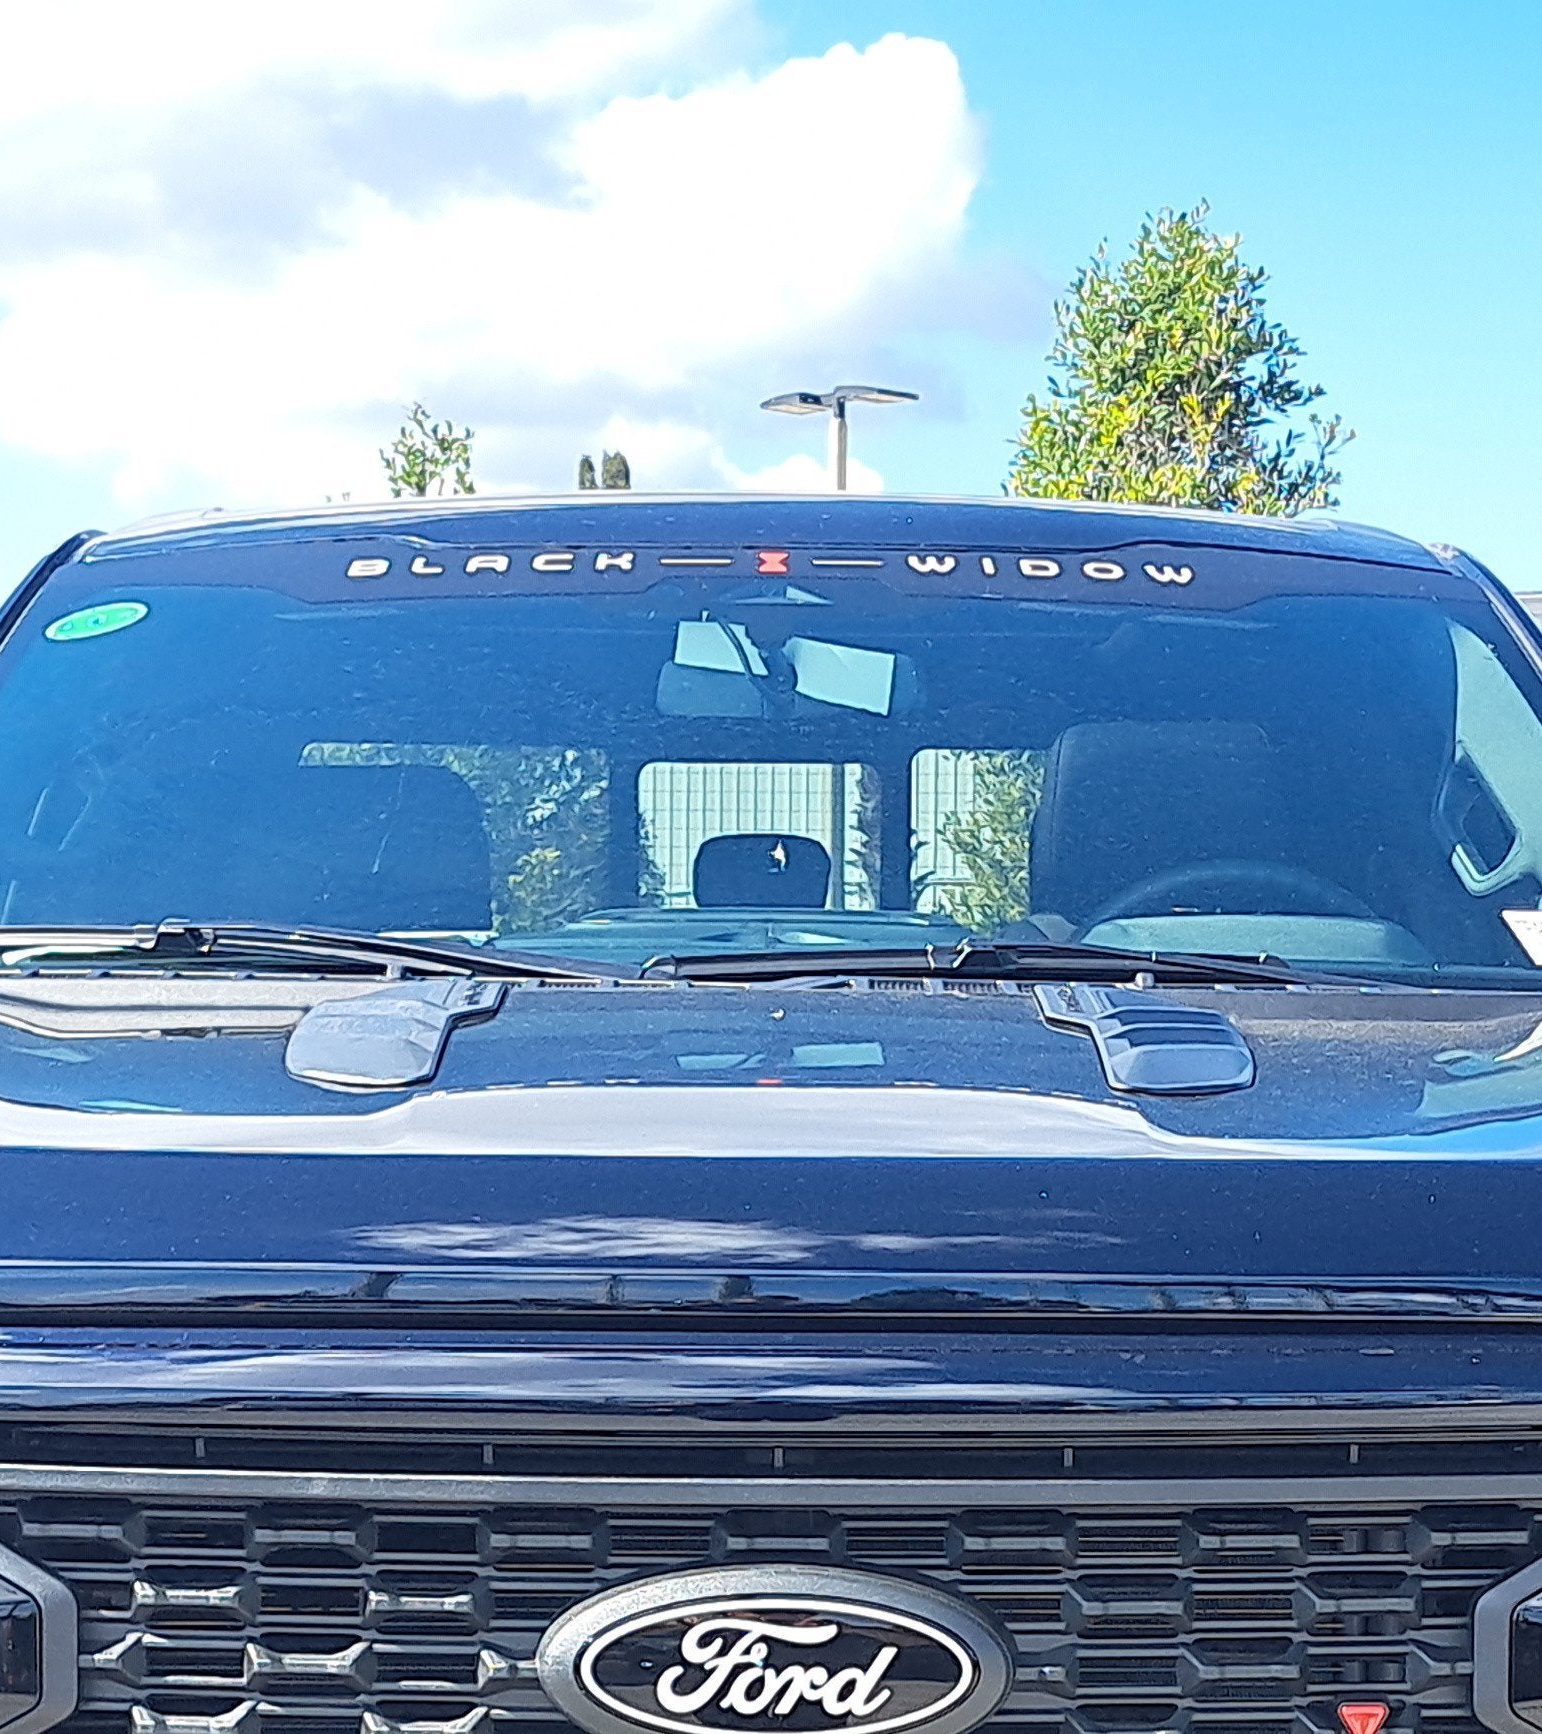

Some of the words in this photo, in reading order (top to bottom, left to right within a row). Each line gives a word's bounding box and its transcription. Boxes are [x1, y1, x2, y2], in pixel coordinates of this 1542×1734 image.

[345, 551, 636, 579] BLACK
[905, 553, 1196, 586] WIDOW
[656, 1618, 899, 1717] Ford
